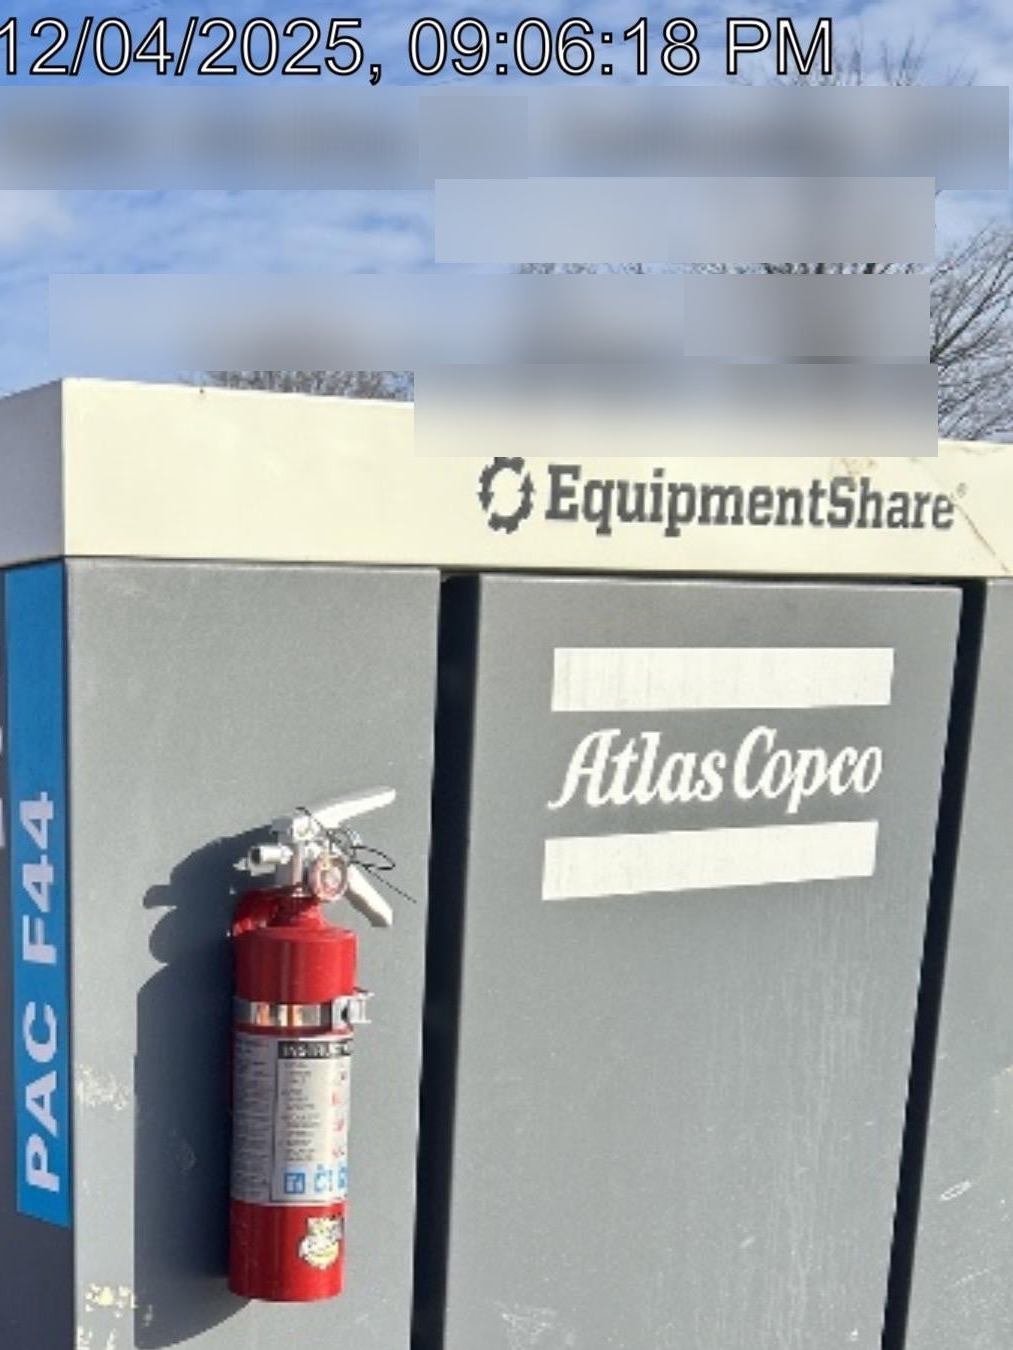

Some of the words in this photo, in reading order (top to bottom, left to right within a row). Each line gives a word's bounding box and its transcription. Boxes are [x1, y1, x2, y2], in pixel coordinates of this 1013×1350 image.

[545, 464, 955, 537] EquipmentShare
[547, 728, 727, 810] Atlas
[733, 726, 883, 814] Copco
[19, 792, 57, 964] F44
[23, 1001, 60, 1192] PAC
